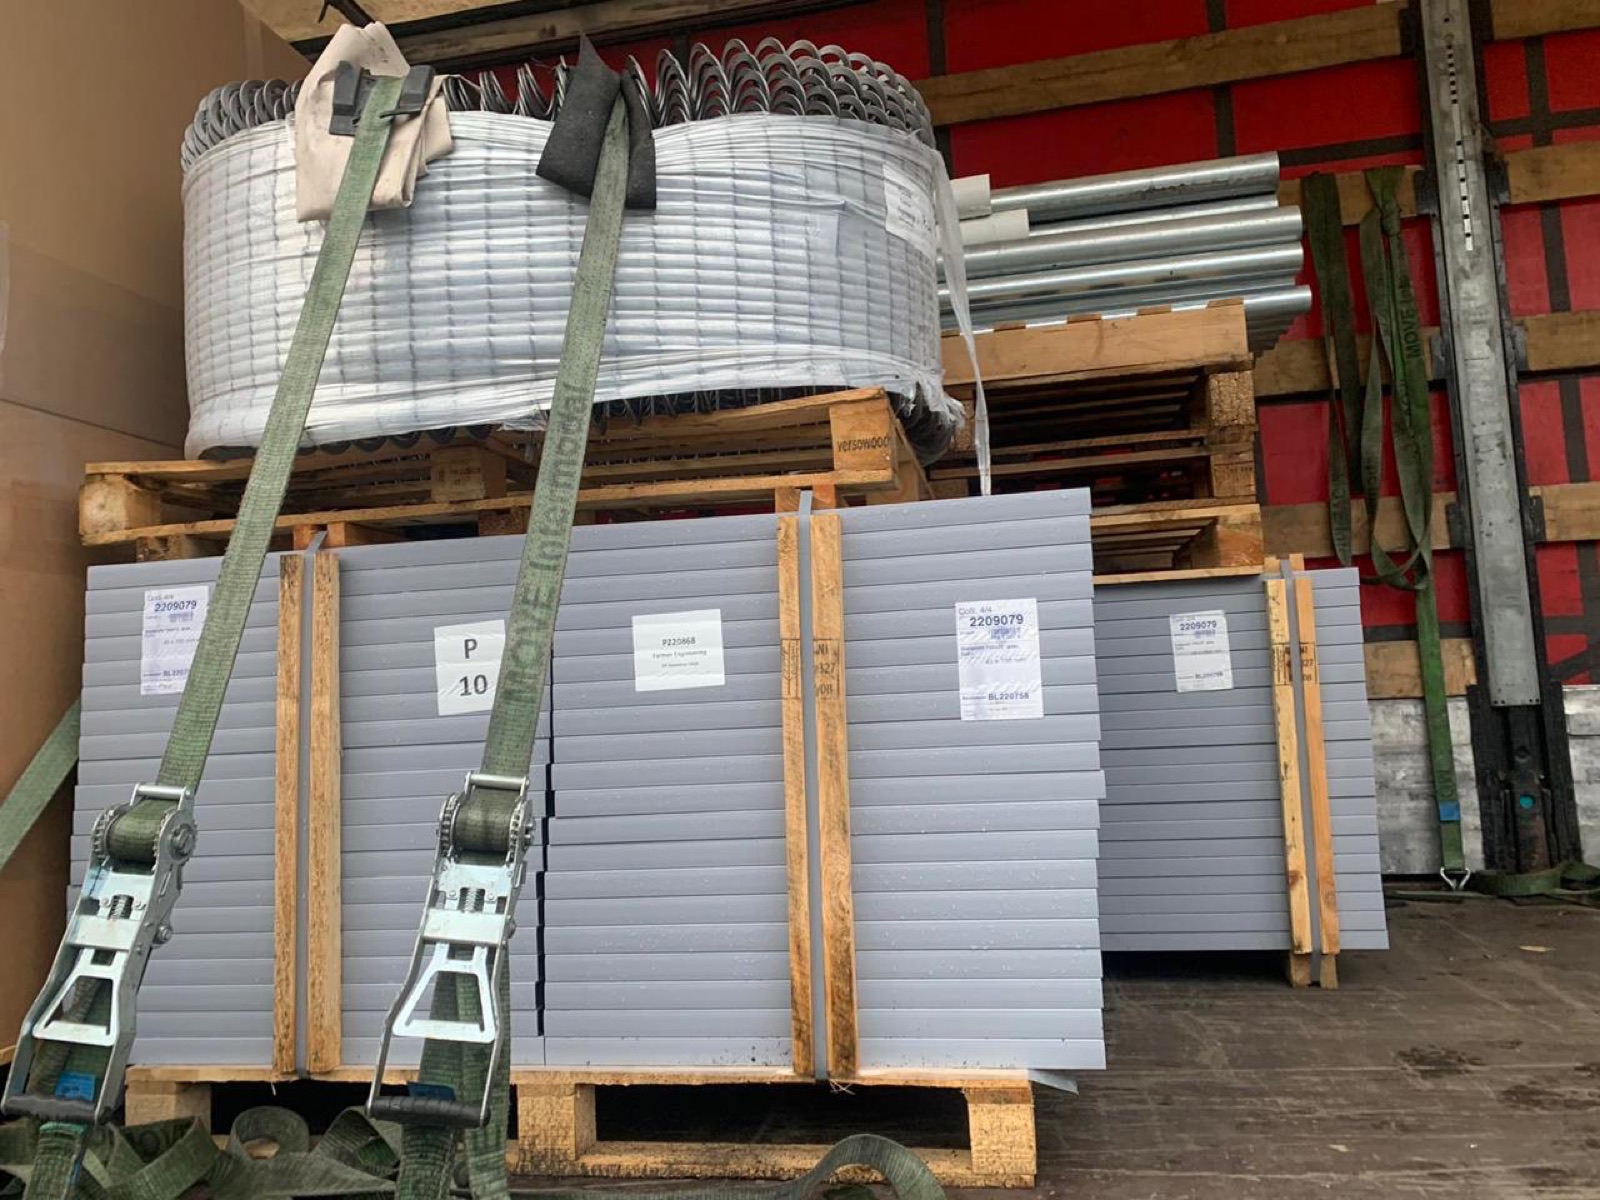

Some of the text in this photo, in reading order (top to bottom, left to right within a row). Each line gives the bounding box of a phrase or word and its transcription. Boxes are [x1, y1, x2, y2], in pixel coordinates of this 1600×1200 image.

[1400, 310, 1421, 359] MOVE
[154, 600, 197, 612] 2209079
[969, 614, 1024, 627] 2209079
[1179, 620, 1217, 631] 2209079
[464, 638, 478, 659] P
[500, 583, 555, 709] MOVE
[459, 674, 488, 696] 10
